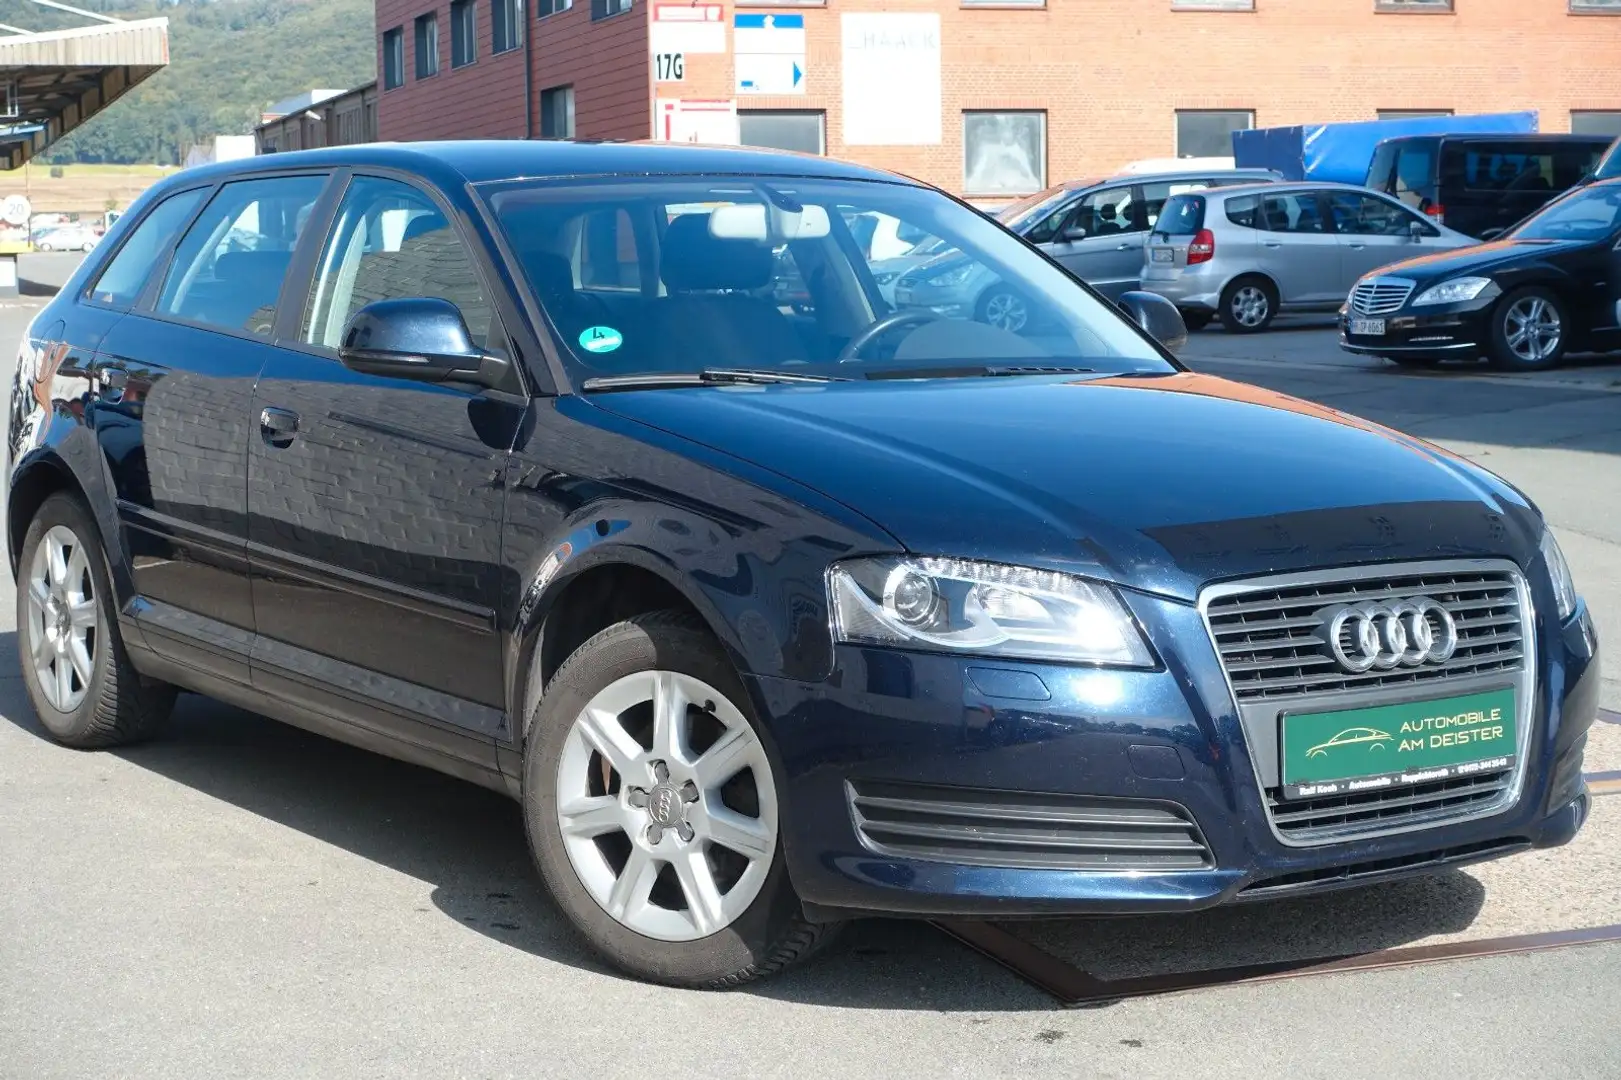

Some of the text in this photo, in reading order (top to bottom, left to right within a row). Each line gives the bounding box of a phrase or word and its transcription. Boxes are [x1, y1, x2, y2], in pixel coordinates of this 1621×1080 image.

[656, 52, 684, 80] 17G
[8, 203, 25, 216] 20
[592, 327, 605, 339] 4
[1399, 708, 1502, 734] AUTOMOBILE
[1397, 725, 1504, 753] AM DEISTER
